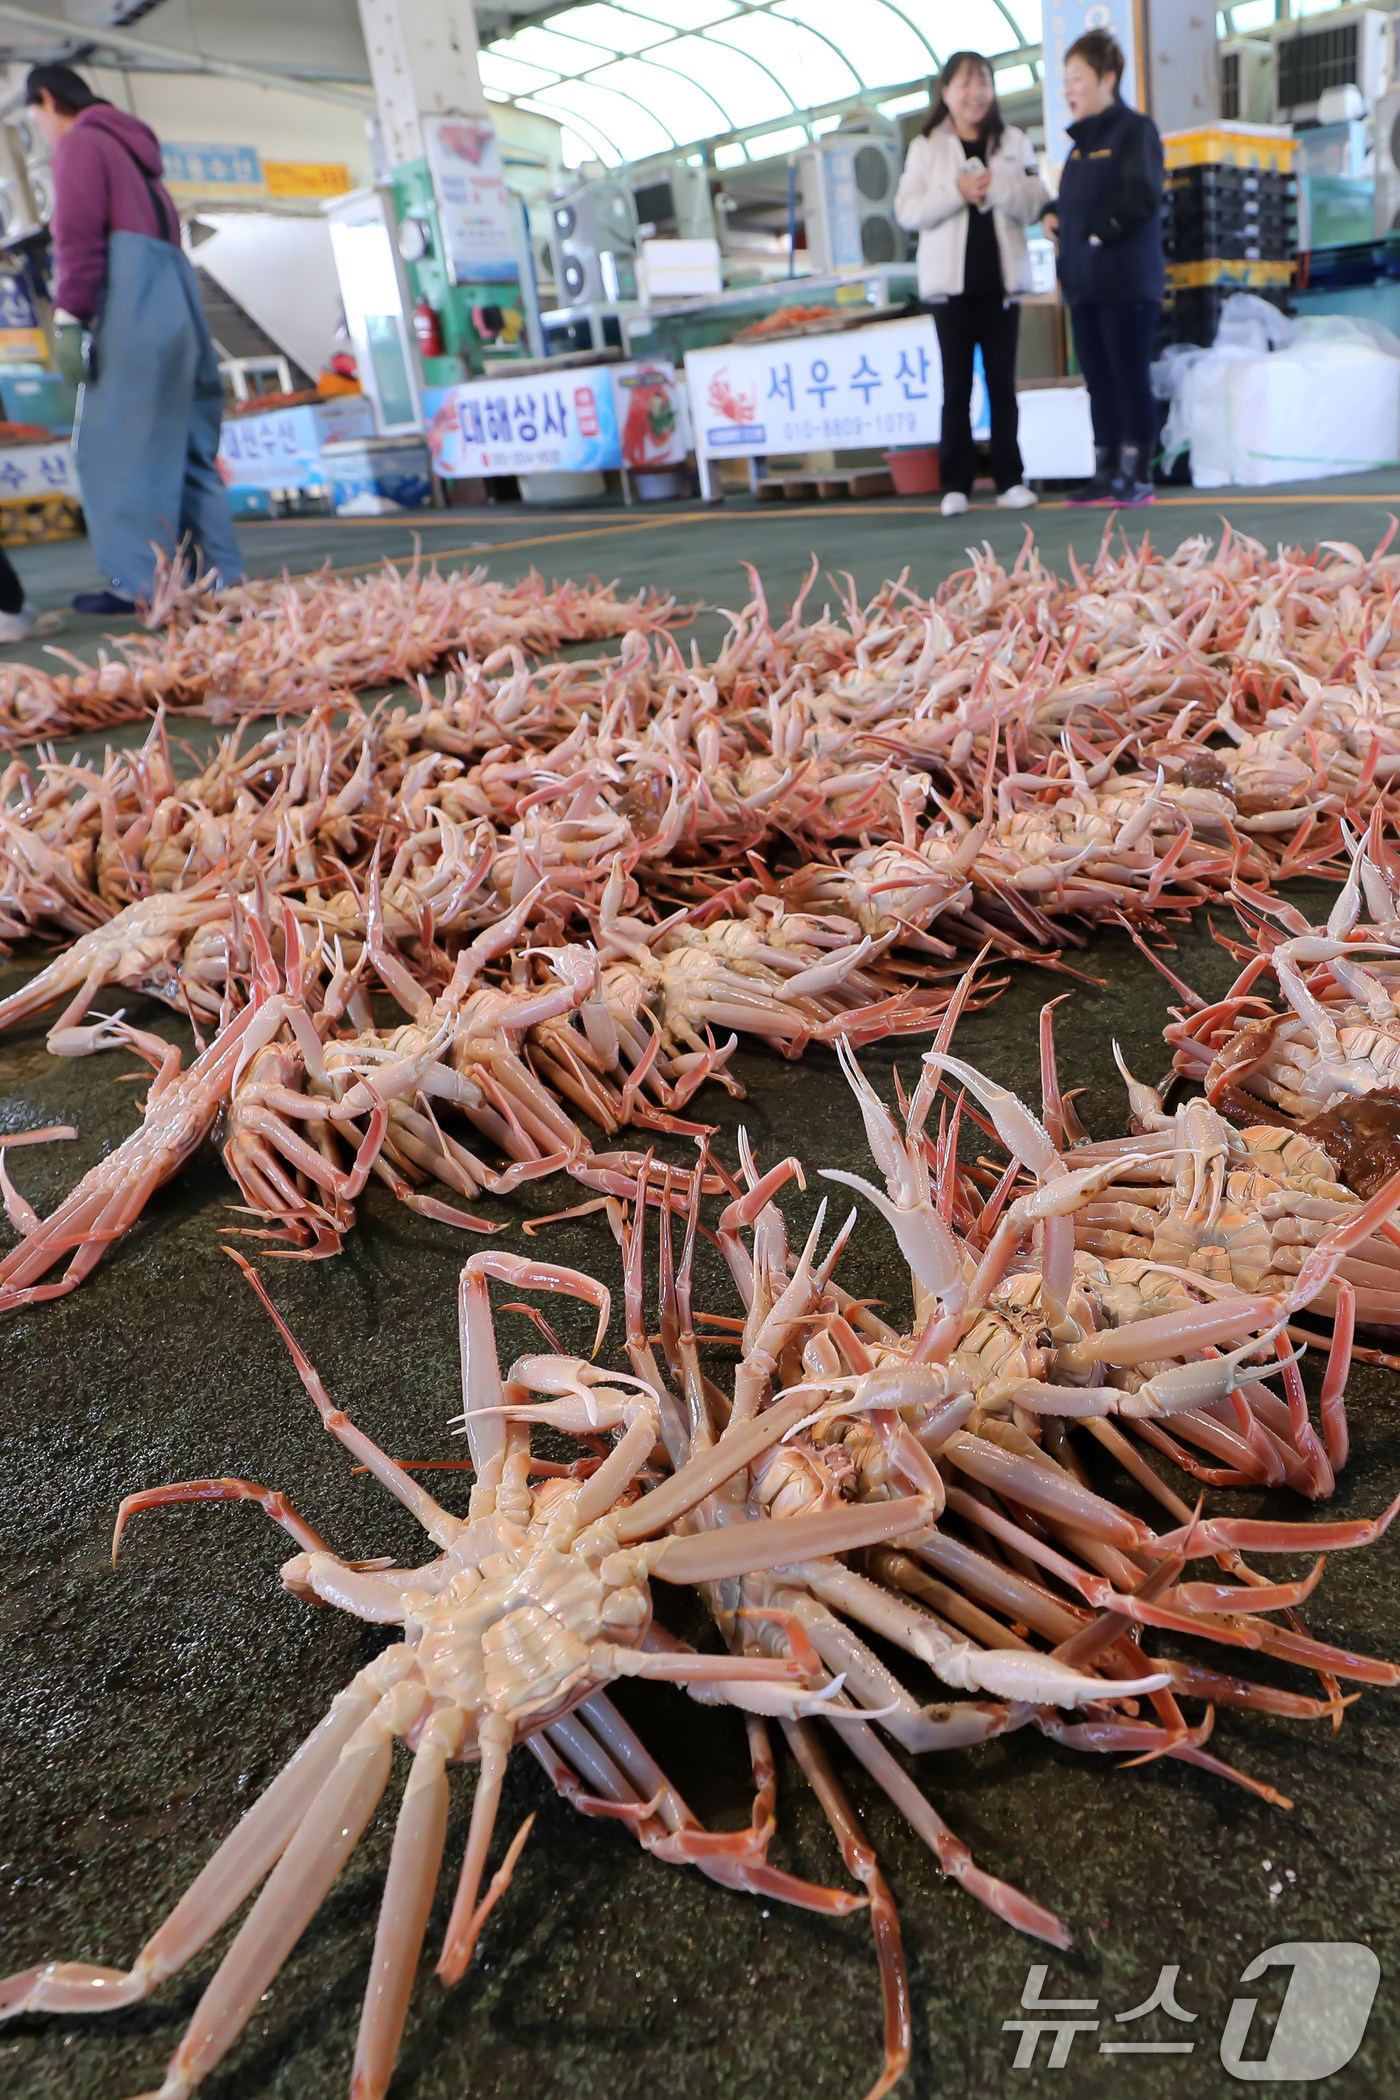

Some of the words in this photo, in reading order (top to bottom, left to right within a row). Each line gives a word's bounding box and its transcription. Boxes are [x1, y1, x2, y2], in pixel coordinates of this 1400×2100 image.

[767, 346, 930, 412] 서우수산
[458, 389, 568, 444] 대해상사
[0, 454, 67, 491] 수산
